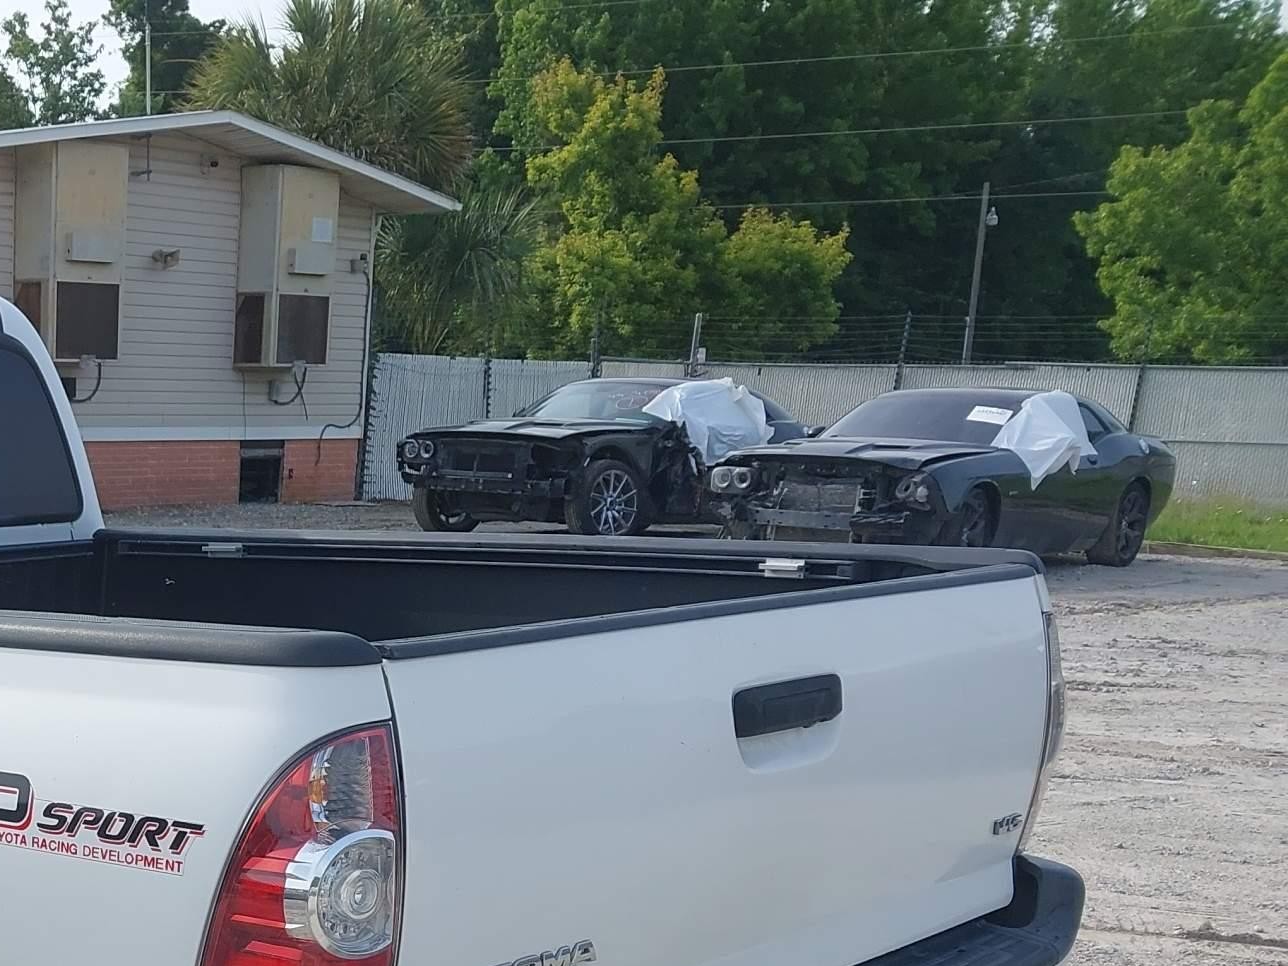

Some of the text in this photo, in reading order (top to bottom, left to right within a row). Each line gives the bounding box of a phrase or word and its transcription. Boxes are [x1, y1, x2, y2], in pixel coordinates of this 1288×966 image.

[37, 802, 206, 854] SPORT
[31, 837, 78, 855] RACING
[82, 845, 184, 873] DEVELOPMENT
